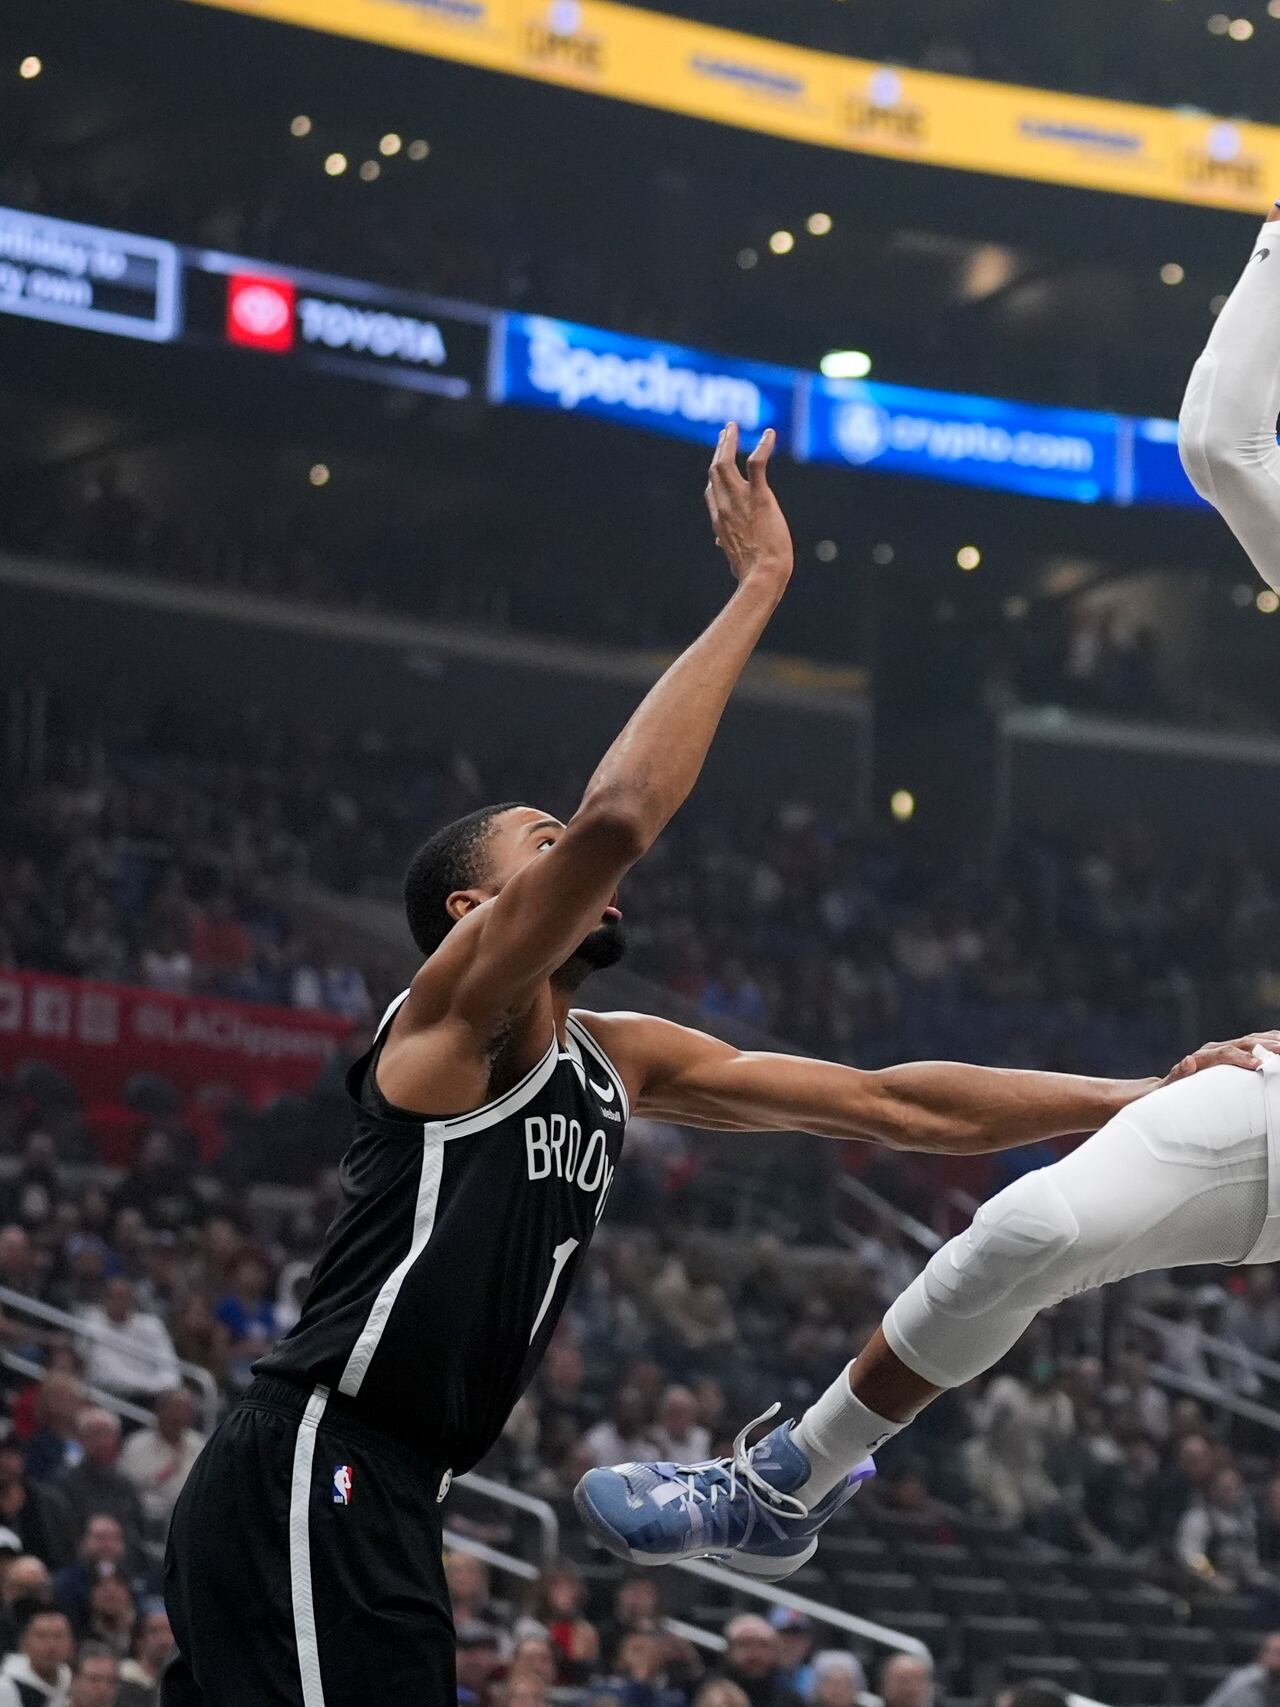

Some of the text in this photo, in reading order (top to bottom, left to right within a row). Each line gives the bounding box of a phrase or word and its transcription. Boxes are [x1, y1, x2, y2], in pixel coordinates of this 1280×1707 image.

[299, 298, 447, 366] TOYOTA
[528, 325, 760, 431] Spectrum
[888, 415, 1094, 472] crypto.com
[528, 1236, 580, 1347] 1
